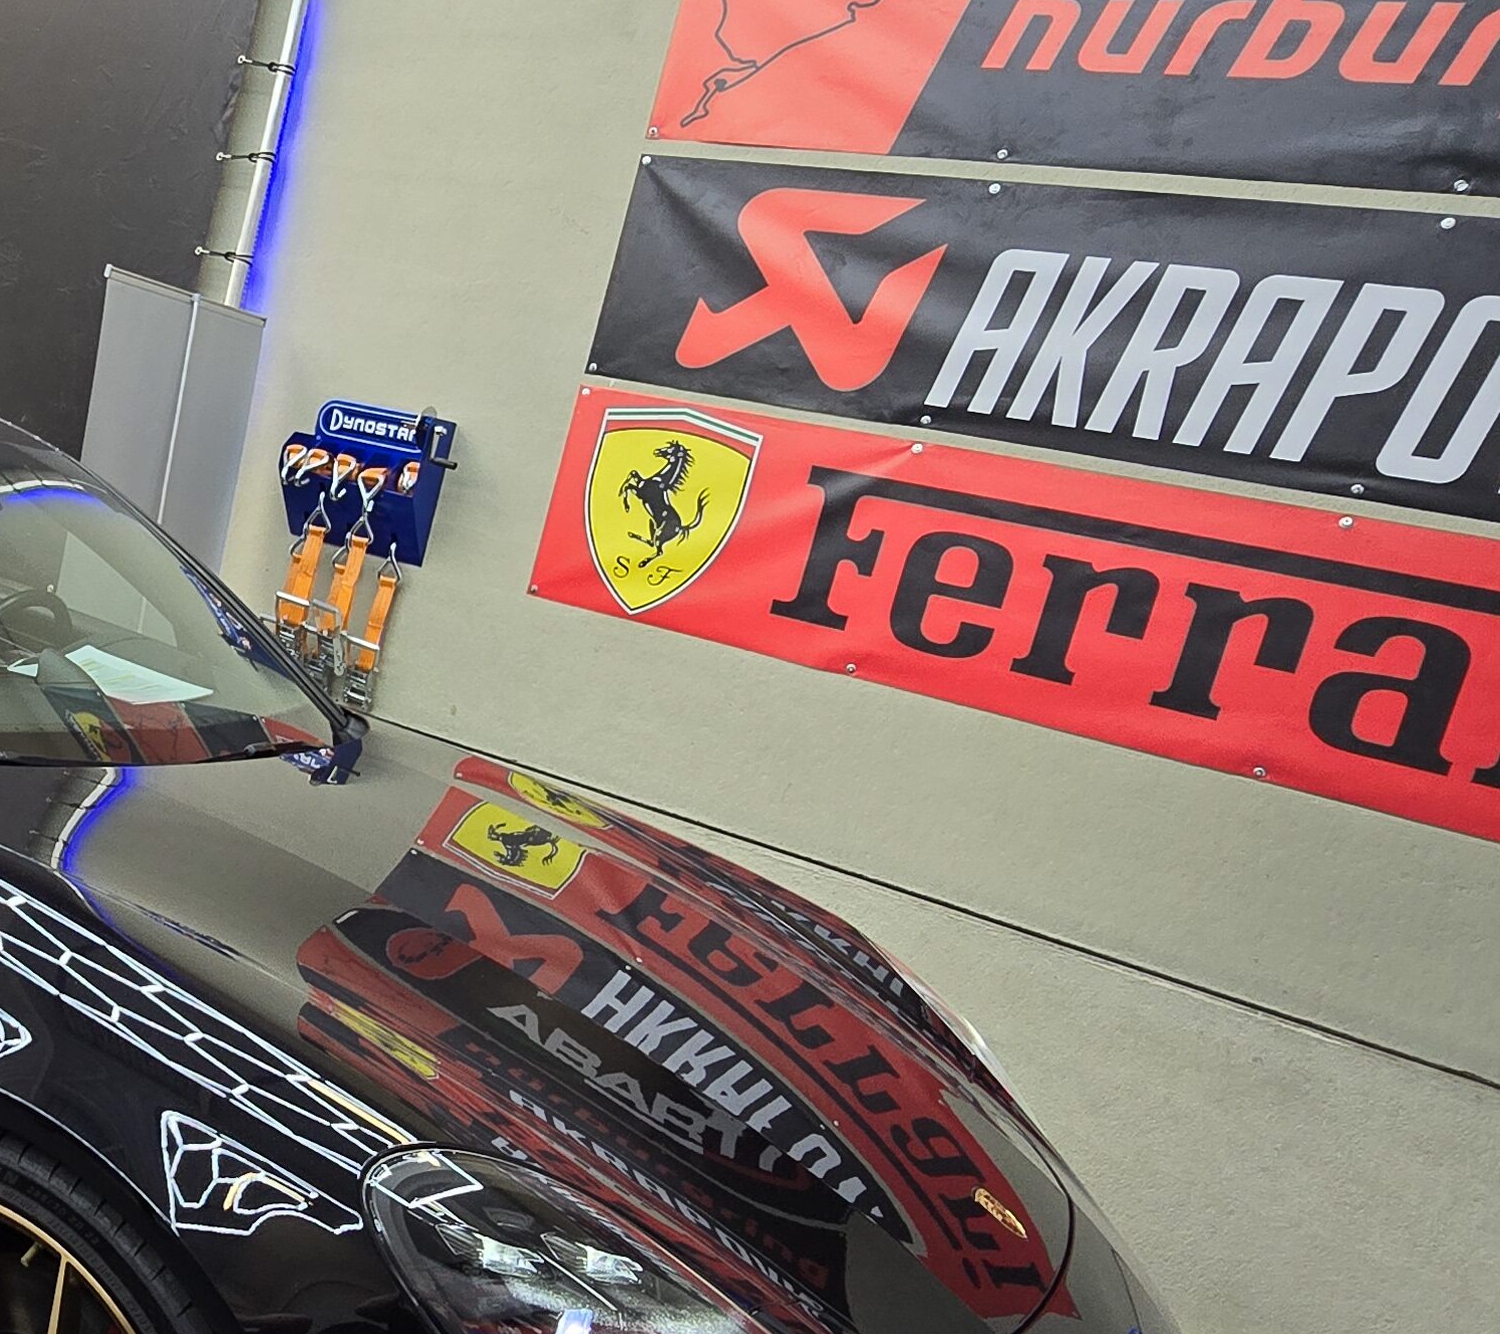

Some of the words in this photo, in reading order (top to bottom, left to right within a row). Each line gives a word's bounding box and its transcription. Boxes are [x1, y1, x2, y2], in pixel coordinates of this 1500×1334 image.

[924, 248, 1500, 485] AKRAPO
[613, 556, 630, 578] S
[770, 465, 1500, 789] Ferra
